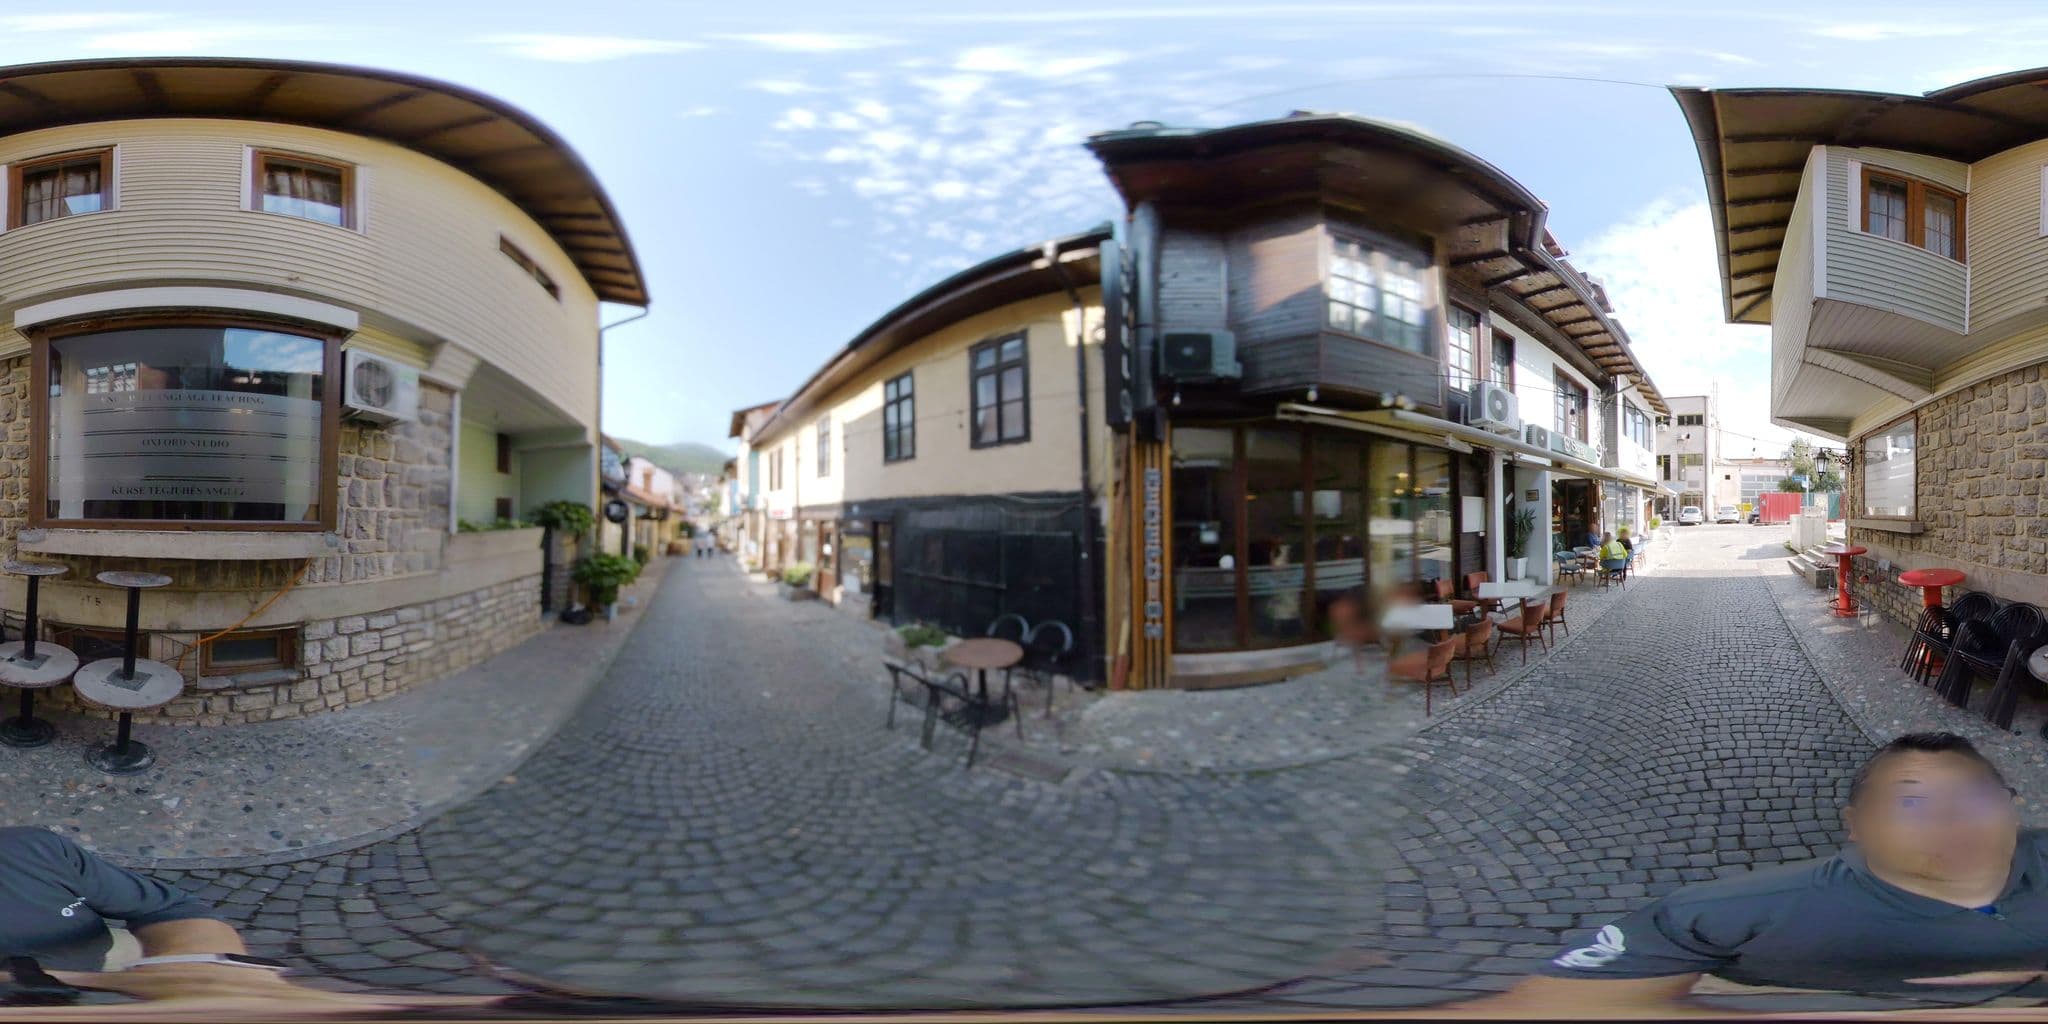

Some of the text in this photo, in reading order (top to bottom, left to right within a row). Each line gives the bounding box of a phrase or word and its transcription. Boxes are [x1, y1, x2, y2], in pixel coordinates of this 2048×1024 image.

[211, 394, 264, 405] TEACHING
[142, 438, 230, 449] OXFORD STUDIO
[111, 484, 145, 496] KURSE
